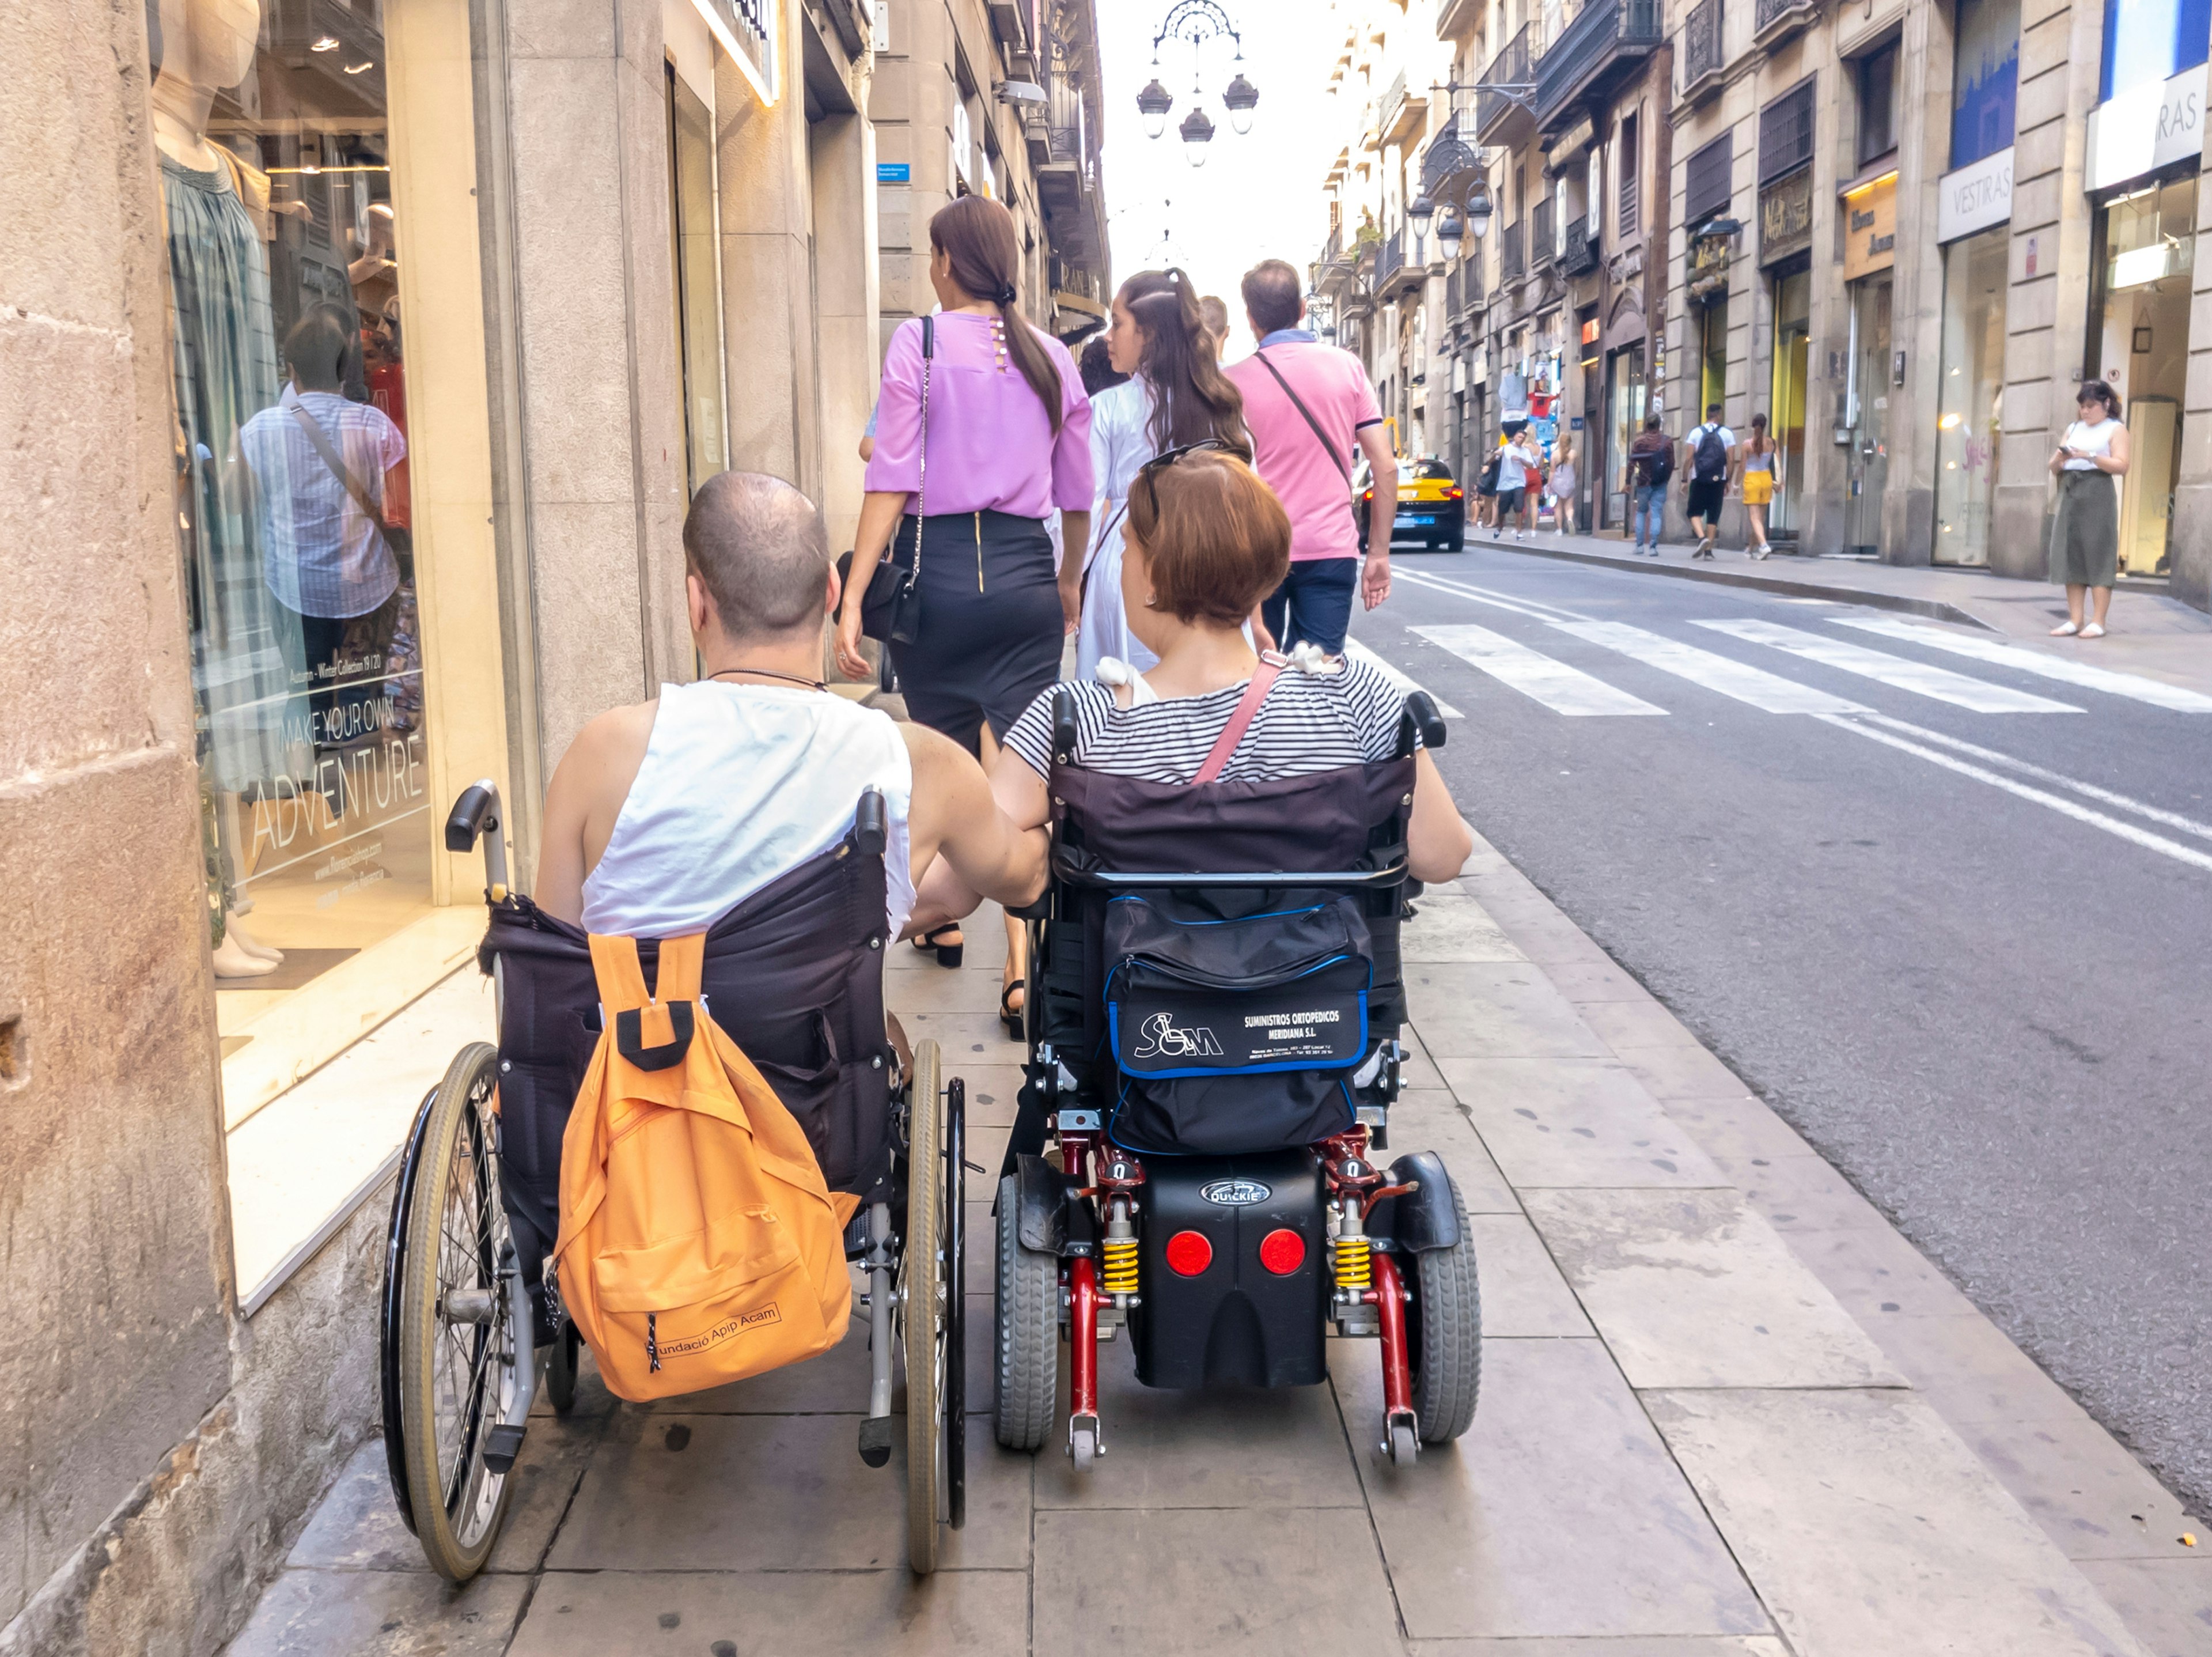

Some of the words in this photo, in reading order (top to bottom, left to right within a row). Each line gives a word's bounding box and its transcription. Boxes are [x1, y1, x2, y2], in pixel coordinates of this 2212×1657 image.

[2156, 92, 2196, 142] RAS
[1953, 166, 2010, 215] VESTIRAS
[1061, 263, 1084, 296] RAN
[317, 662, 337, 679] Winter
[338, 659, 363, 676] Collection
[281, 709, 322, 754] MAKE
[321, 700, 362, 742] YOUR
[362, 695, 396, 730] OWN
[252, 735, 422, 858] ADVENTURE
[1244, 1013, 1291, 1028] SUMINISTROS
[1291, 1008, 1339, 1025] ORTOPÉDICOS
[1268, 1027, 1304, 1040] MERIDIANA
[1305, 1027, 1316, 1038] S.L.
[1210, 1191, 1260, 1202] QUICKIE
[657, 1335, 710, 1356] undació
[712, 1320, 738, 1342] Apip
[741, 1307, 776, 1327] Acam
